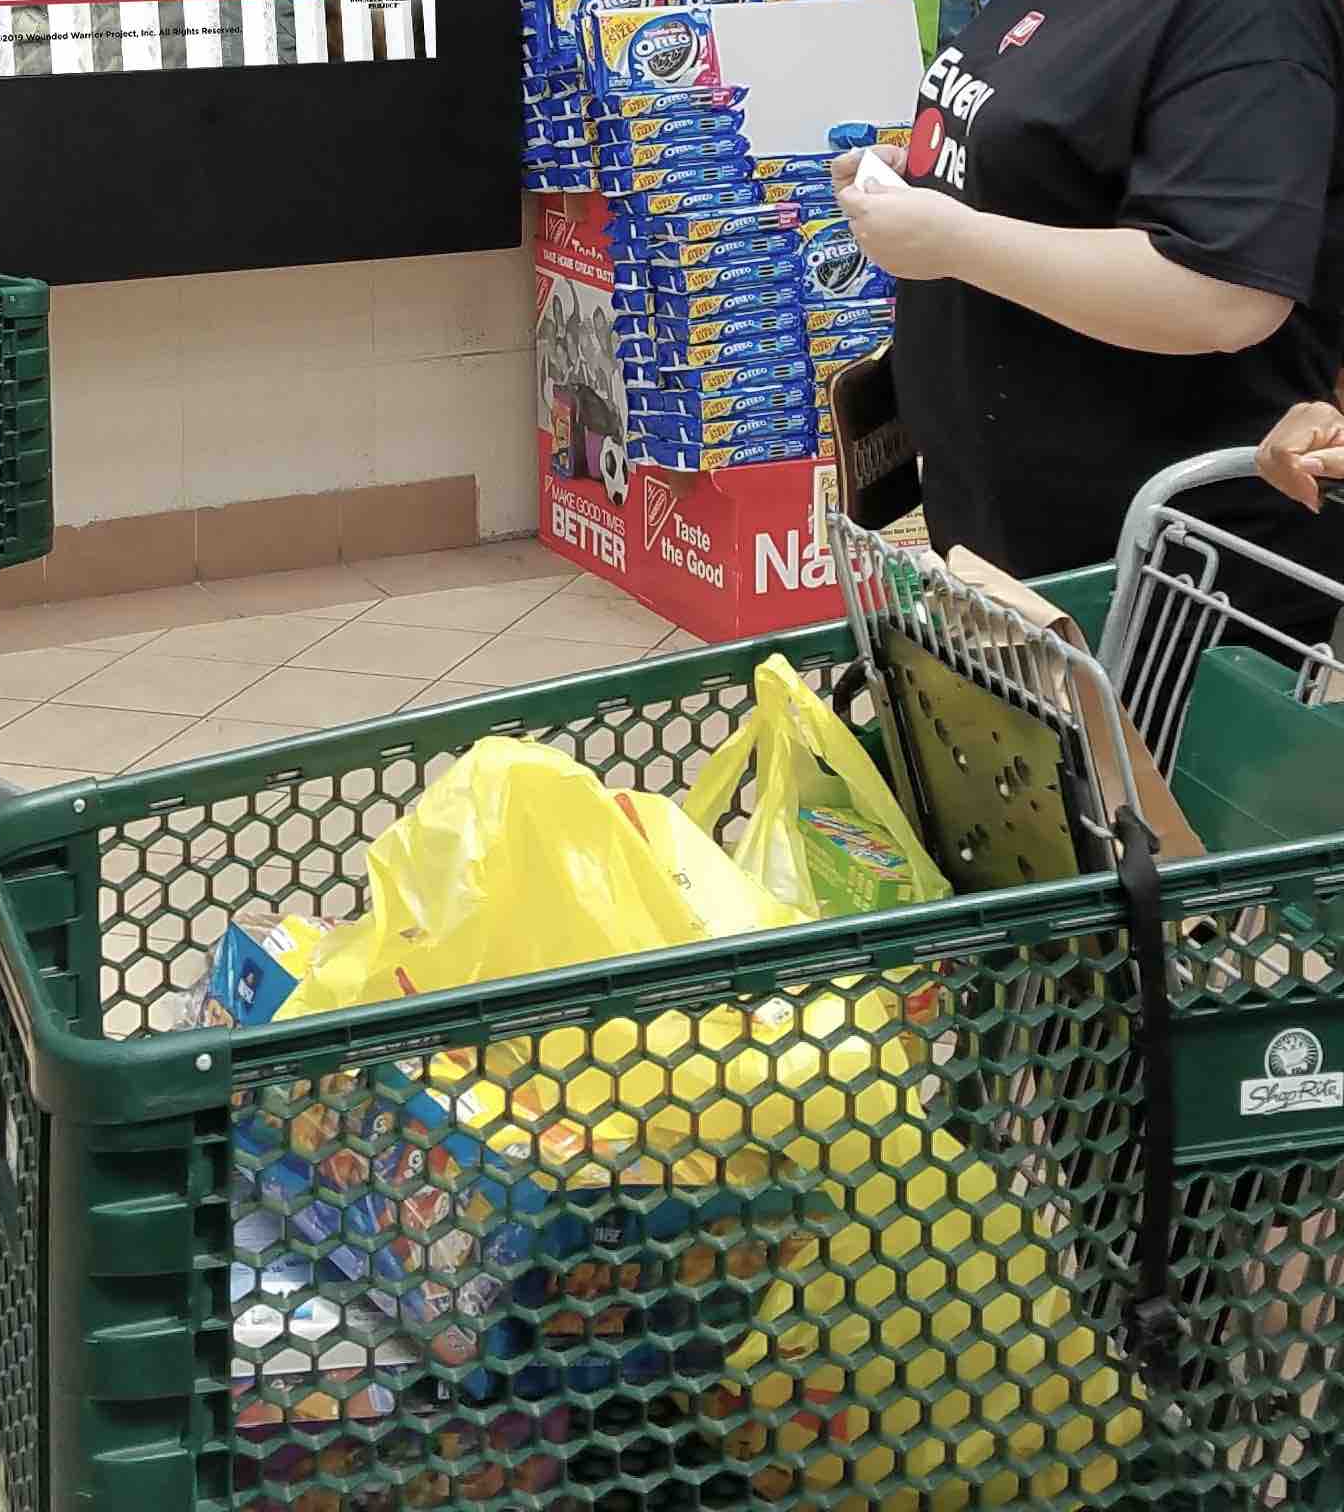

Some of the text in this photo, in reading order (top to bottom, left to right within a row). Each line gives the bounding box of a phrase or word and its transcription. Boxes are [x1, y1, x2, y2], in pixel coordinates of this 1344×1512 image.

[26, 32, 68, 42] Wounded
[71, 31, 103, 40] Warrior
[106, 30, 139, 39] Project,
[141, 29, 156, 37] Inc.
[159, 28, 170, 36] All
[173, 27, 199, 37] Rights
[635, 34, 690, 57] OREO
[919, 46, 995, 137] Every
[807, 242, 859, 266] OREO
[552, 485, 625, 534] MAKE GOOD TIMES
[552, 504, 626, 573] BETTER
[672, 512, 712, 552] Taste
[661, 535, 724, 589] the Good
[1247, 1079, 1338, 1113] ShopRite
